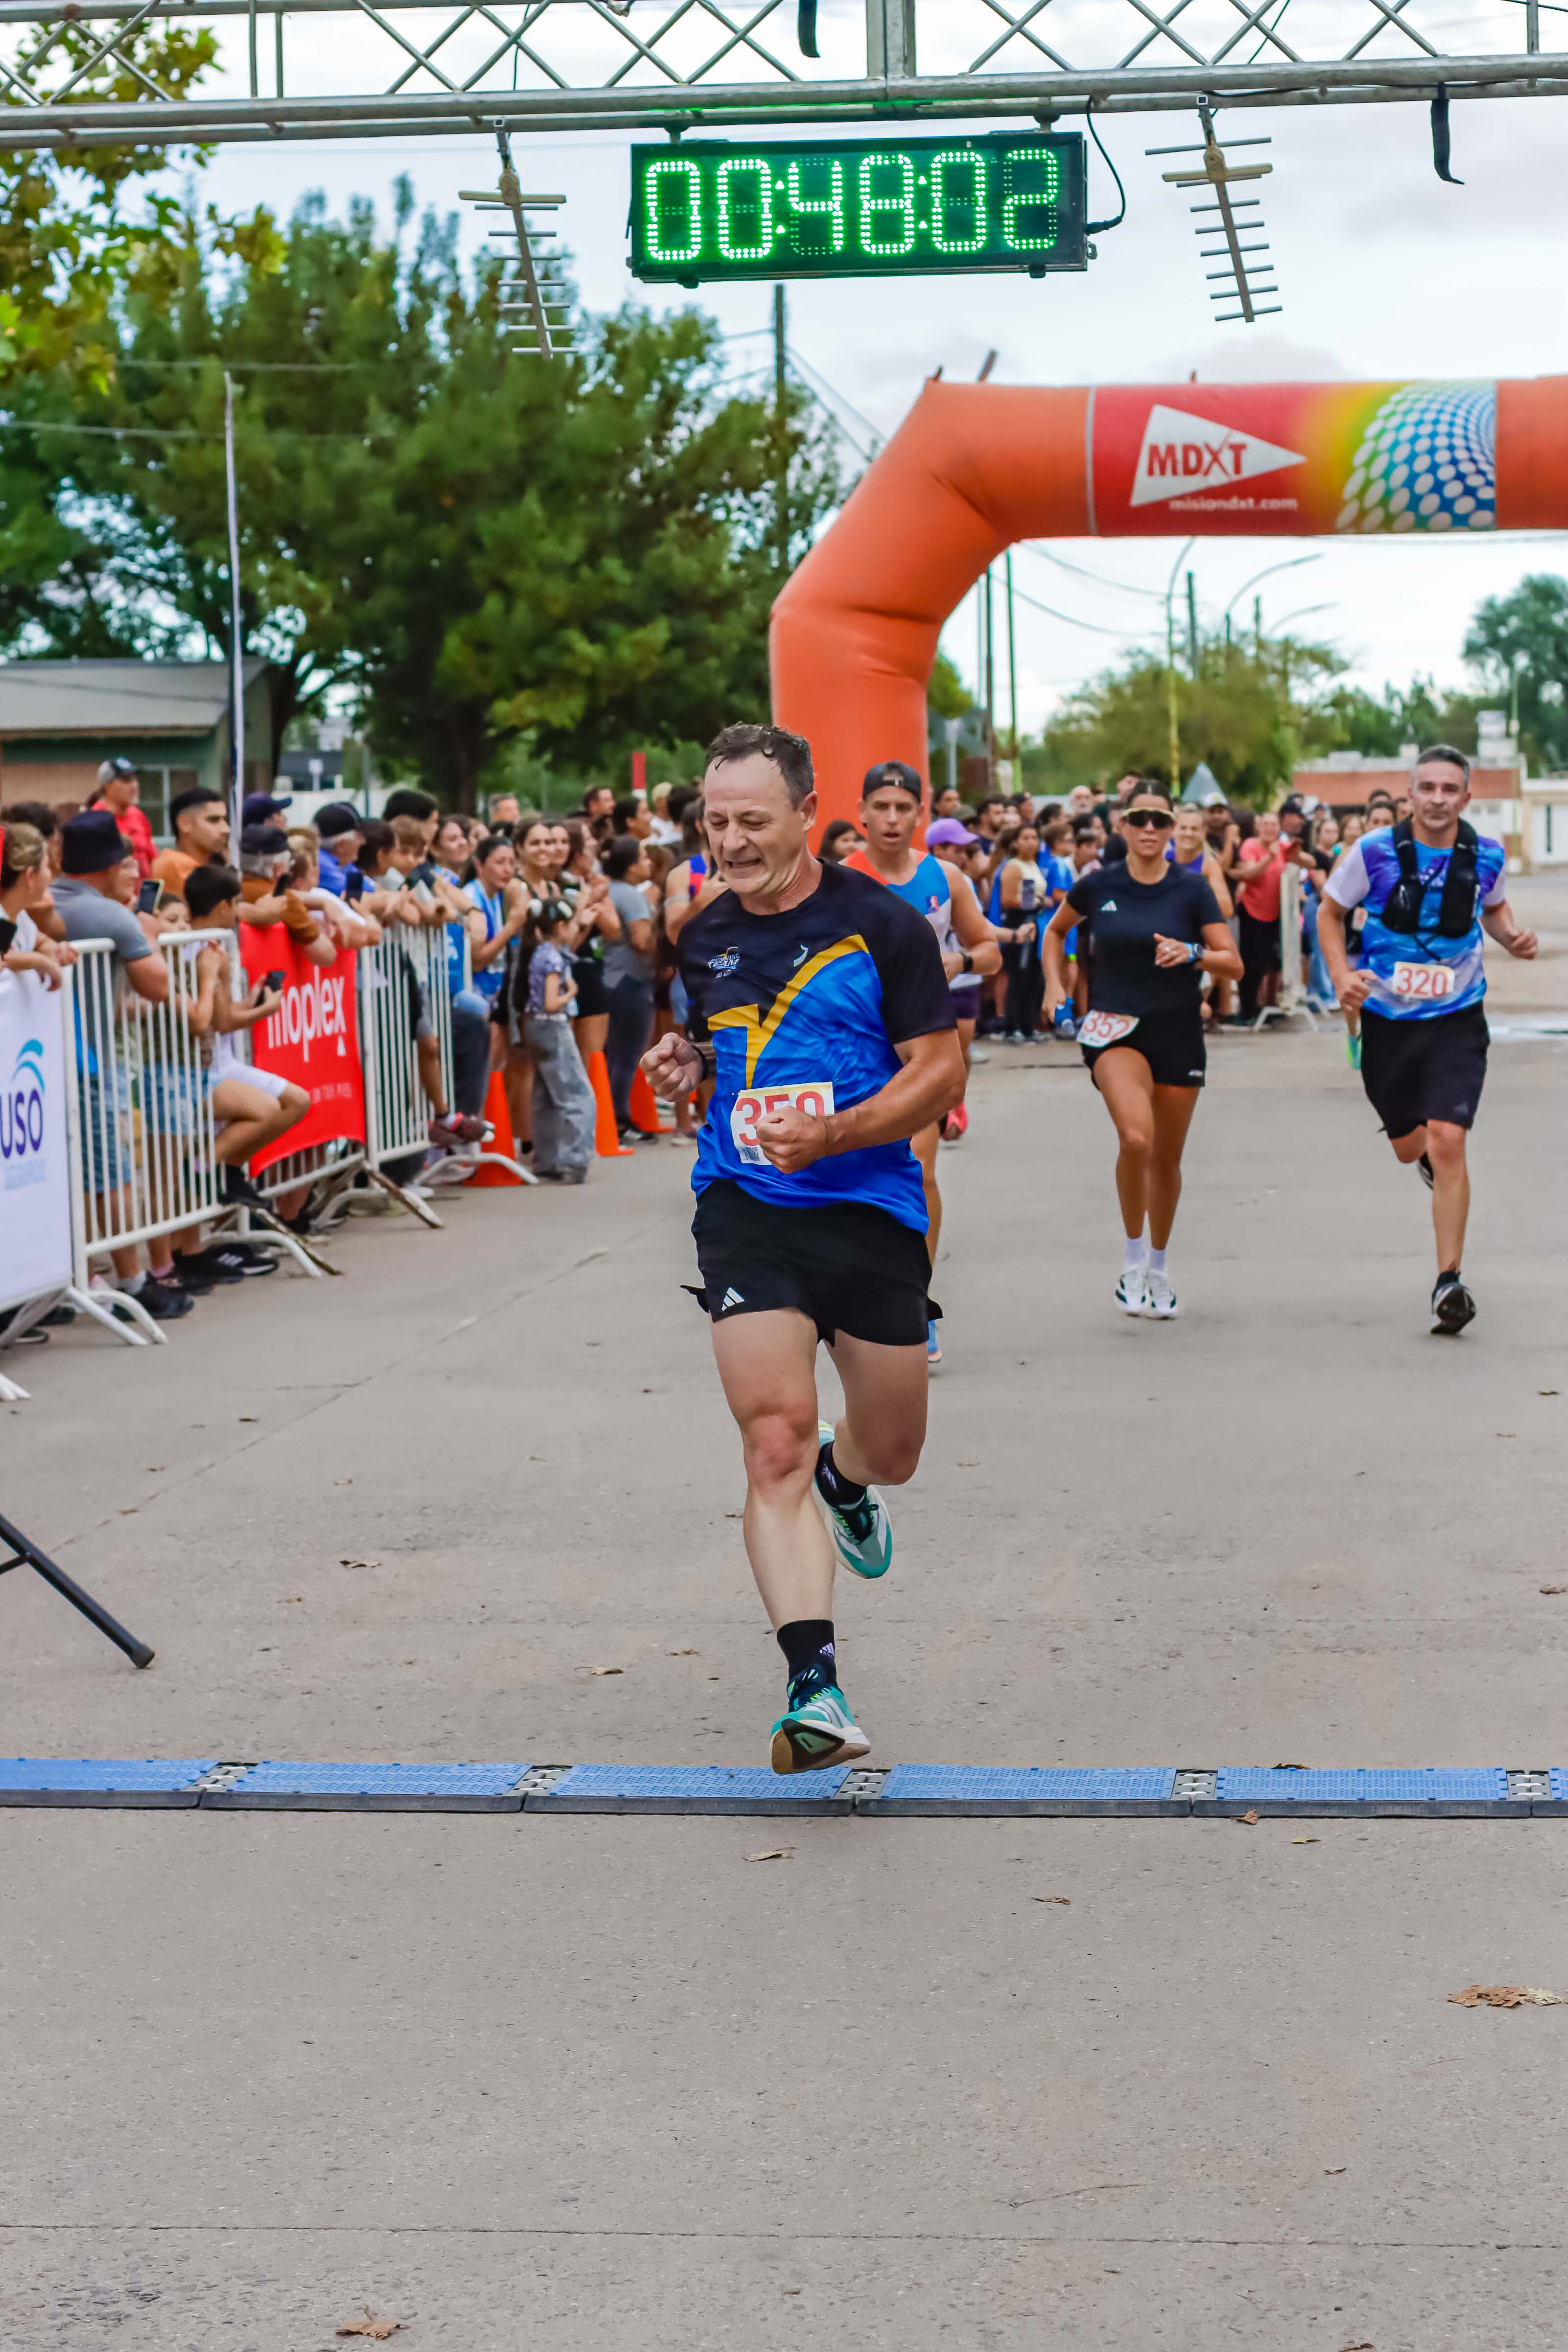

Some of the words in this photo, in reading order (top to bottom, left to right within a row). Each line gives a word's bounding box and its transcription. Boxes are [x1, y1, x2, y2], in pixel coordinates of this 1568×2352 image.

[646, 148, 1058, 261] 00:48:02
[1147, 442, 1247, 477] MDXT
[707, 958, 740, 968] TEAM
[1397, 967, 1447, 996] 320
[1083, 1011, 1130, 1042] 352
